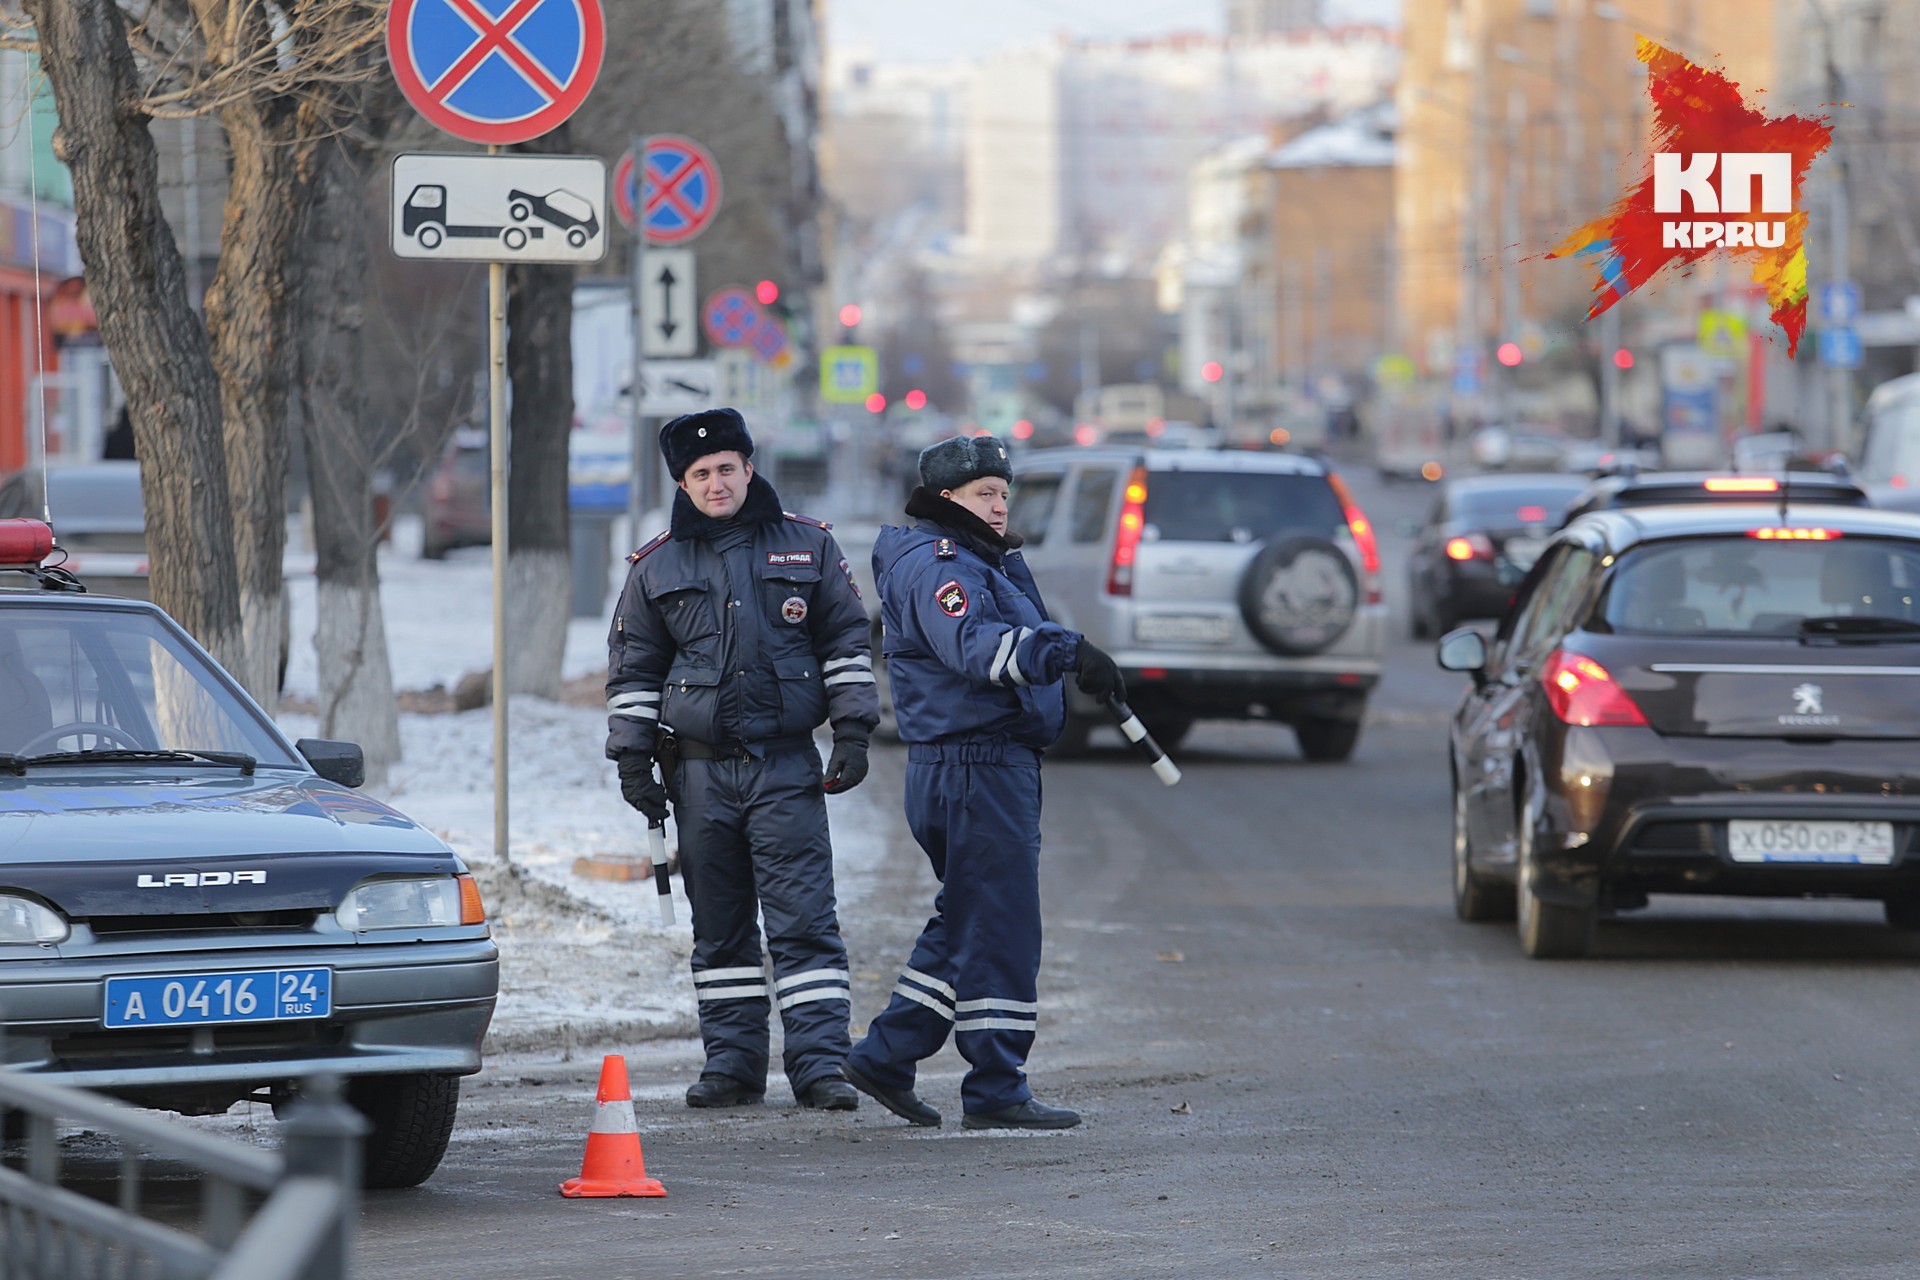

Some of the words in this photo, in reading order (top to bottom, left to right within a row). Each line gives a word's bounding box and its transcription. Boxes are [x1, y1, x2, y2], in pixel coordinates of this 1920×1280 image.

[770, 555, 786, 563] ДПС
[786, 554, 811, 562] ГИБДД
[137, 870, 267, 888] LADA
[123, 991, 146, 1020] А
[162, 978, 258, 1018] 0416
[281, 973, 317, 1003] 24
[285, 1003, 313, 1014] RUS
